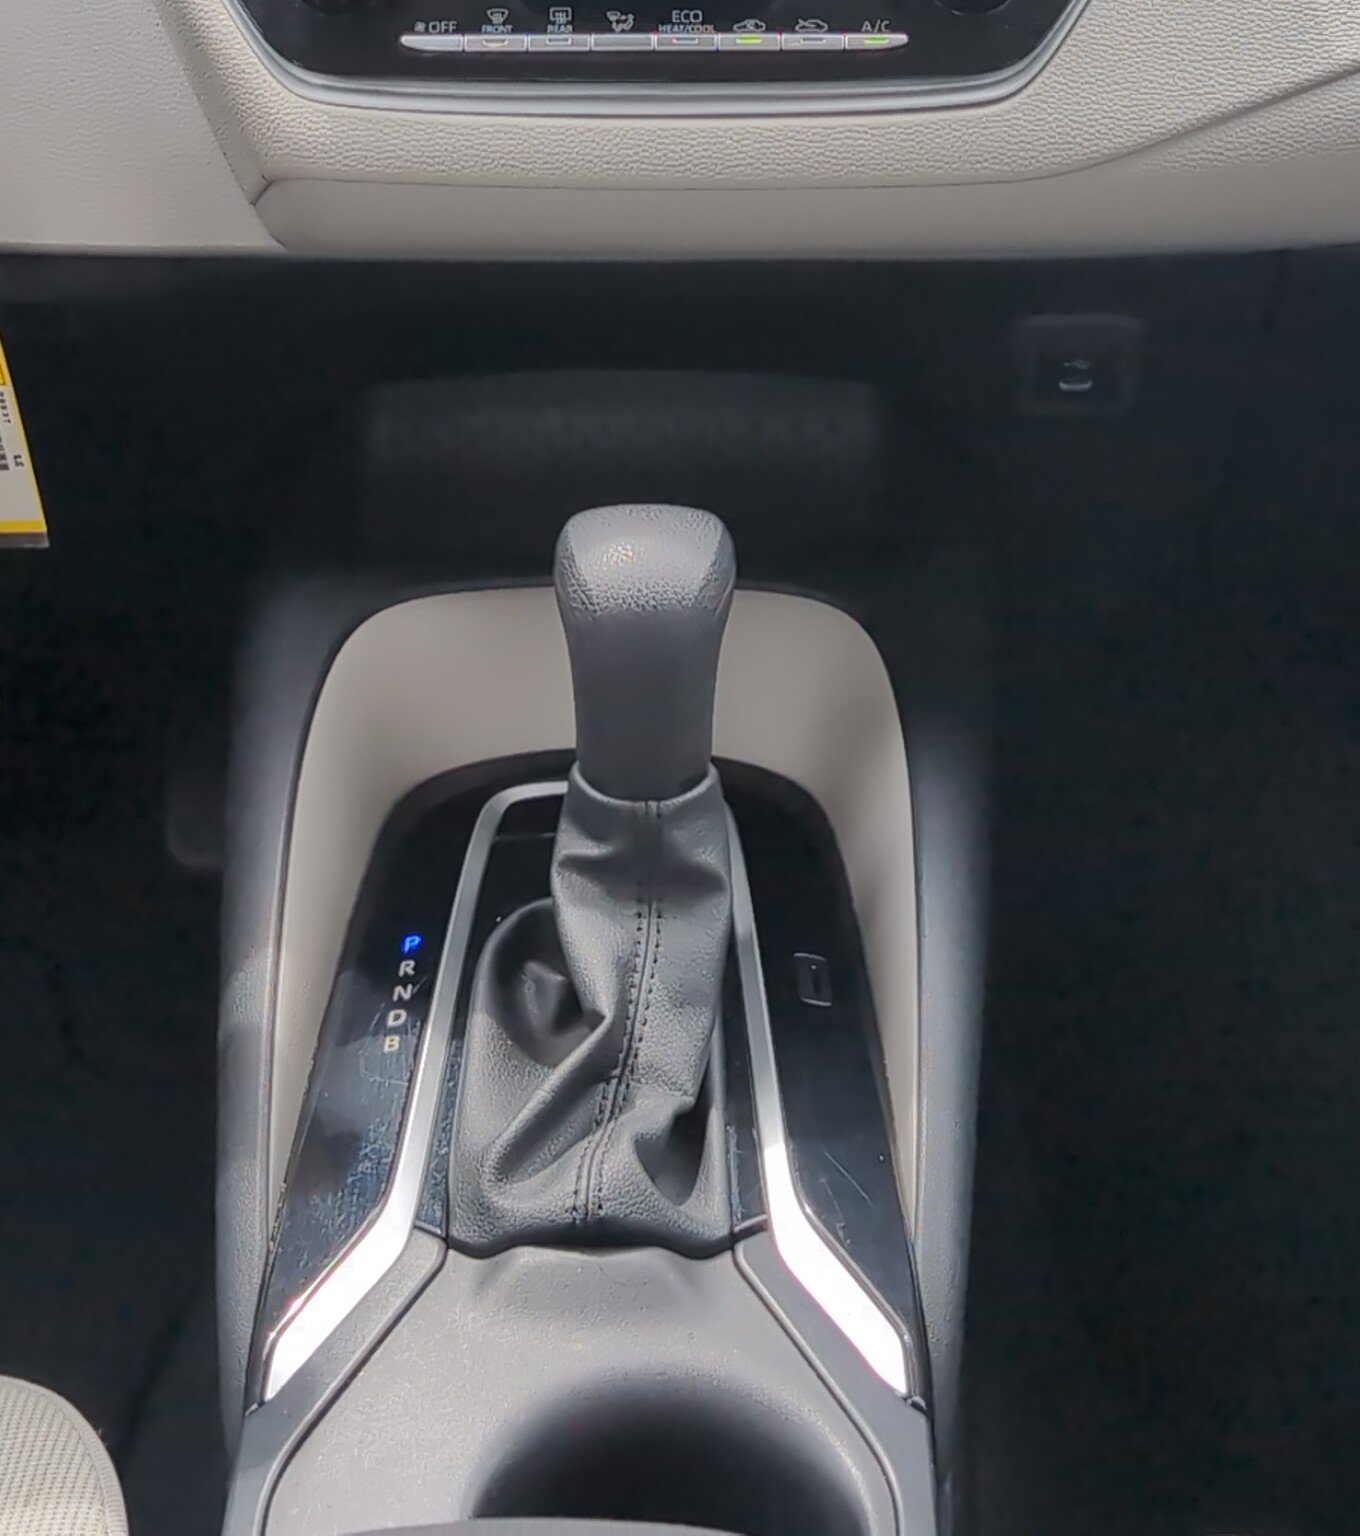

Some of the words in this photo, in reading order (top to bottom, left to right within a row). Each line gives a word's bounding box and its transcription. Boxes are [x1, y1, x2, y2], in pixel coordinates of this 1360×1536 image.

[671, 9, 703, 24] ECO
[428, 21, 458, 34] OFF
[481, 24, 514, 34] FRONT
[545, 24, 574, 34] REAR
[658, 24, 716, 35] HEAT/COOL
[860, 19, 891, 34] A/C
[403, 934, 422, 954] P
[398, 959, 416, 978] R
[392, 984, 413, 1002] N
[387, 1009, 407, 1027] D
[383, 1035, 400, 1053] B
